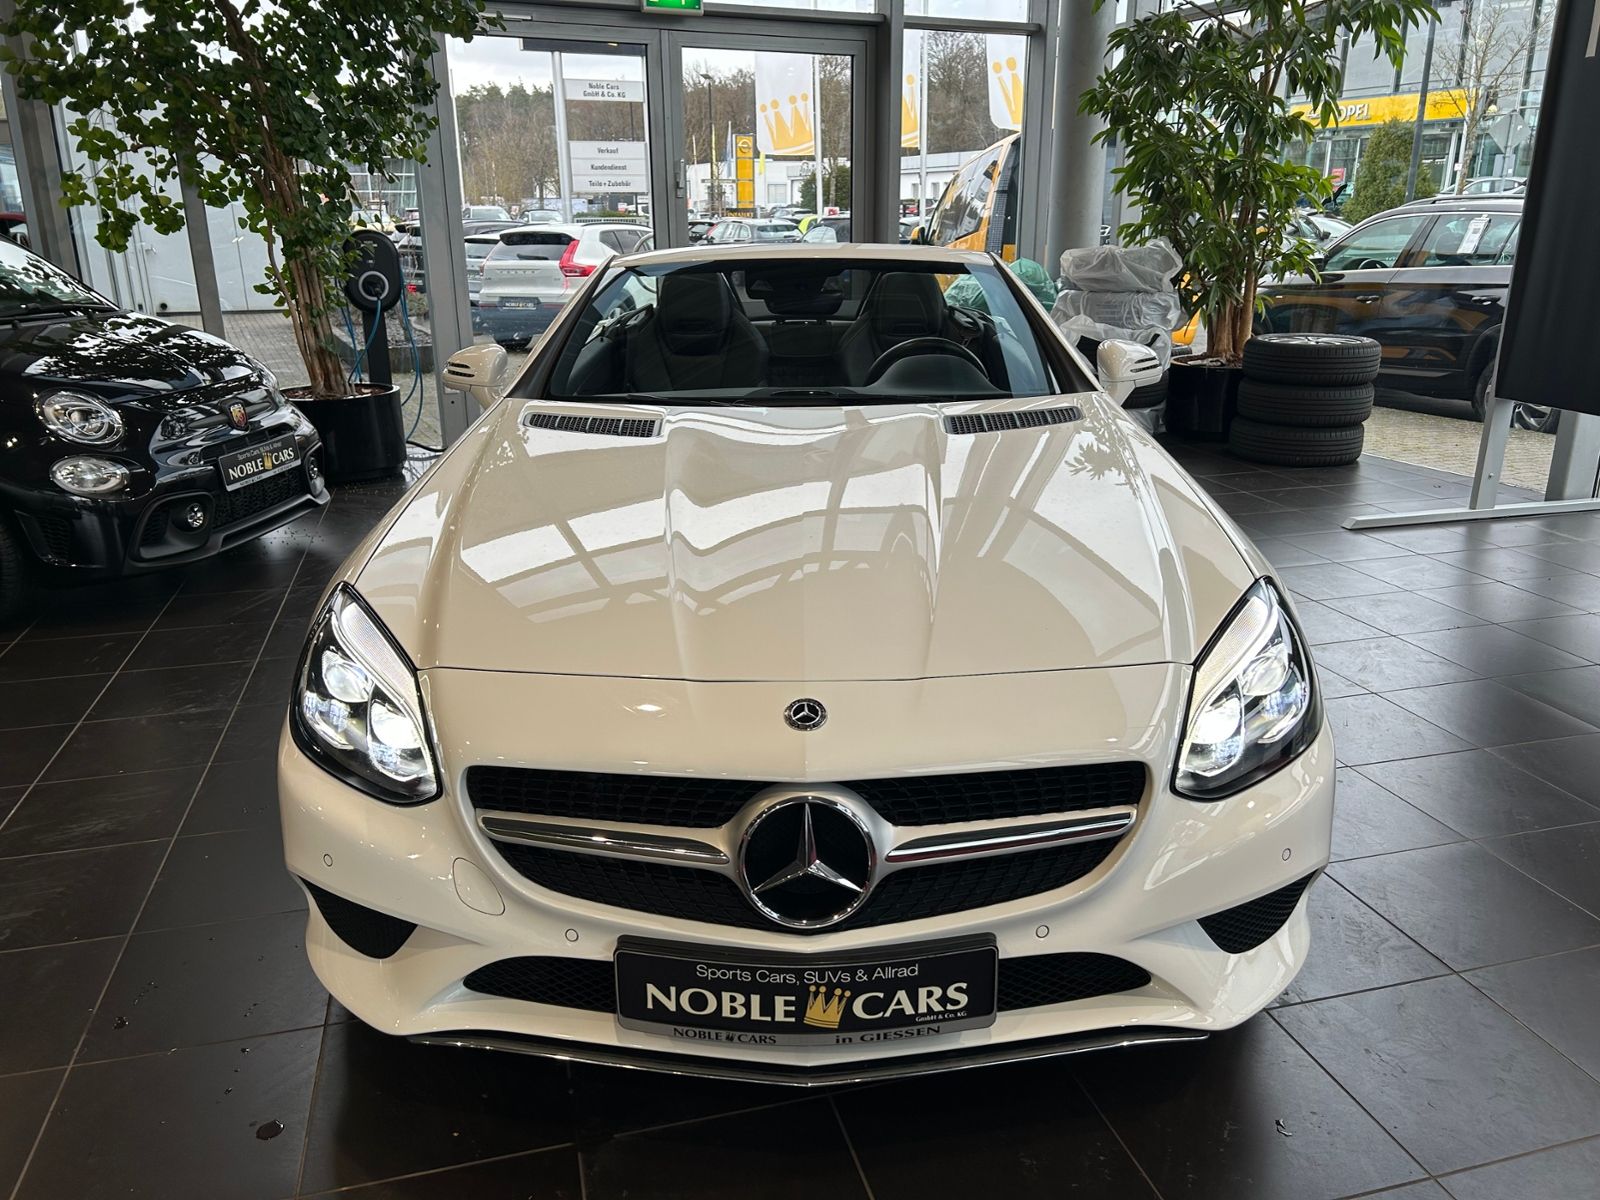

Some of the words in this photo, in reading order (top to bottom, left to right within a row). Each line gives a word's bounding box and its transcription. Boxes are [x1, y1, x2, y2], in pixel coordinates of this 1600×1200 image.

[588, 82, 605, 90] Noble
[1337, 103, 1371, 122] OPEL
[228, 458, 264, 480] NOBLE
[272, 447, 295, 465] CARS
[696, 964, 752, 983] Sports
[756, 969, 800, 986] Cars,
[804, 969, 851, 984] SUVs
[855, 969, 868, 982] &
[872, 963, 919, 981] Allrad
[645, 982, 796, 1023] NOBLE
[852, 981, 969, 1020] CARS
[915, 1014, 937, 1022] GmbH
[673, 1027, 723, 1041] NOBLE
[737, 1033, 777, 1044] CARS
[835, 1035, 852, 1044] in
[860, 1025, 941, 1042] GIESSEN
